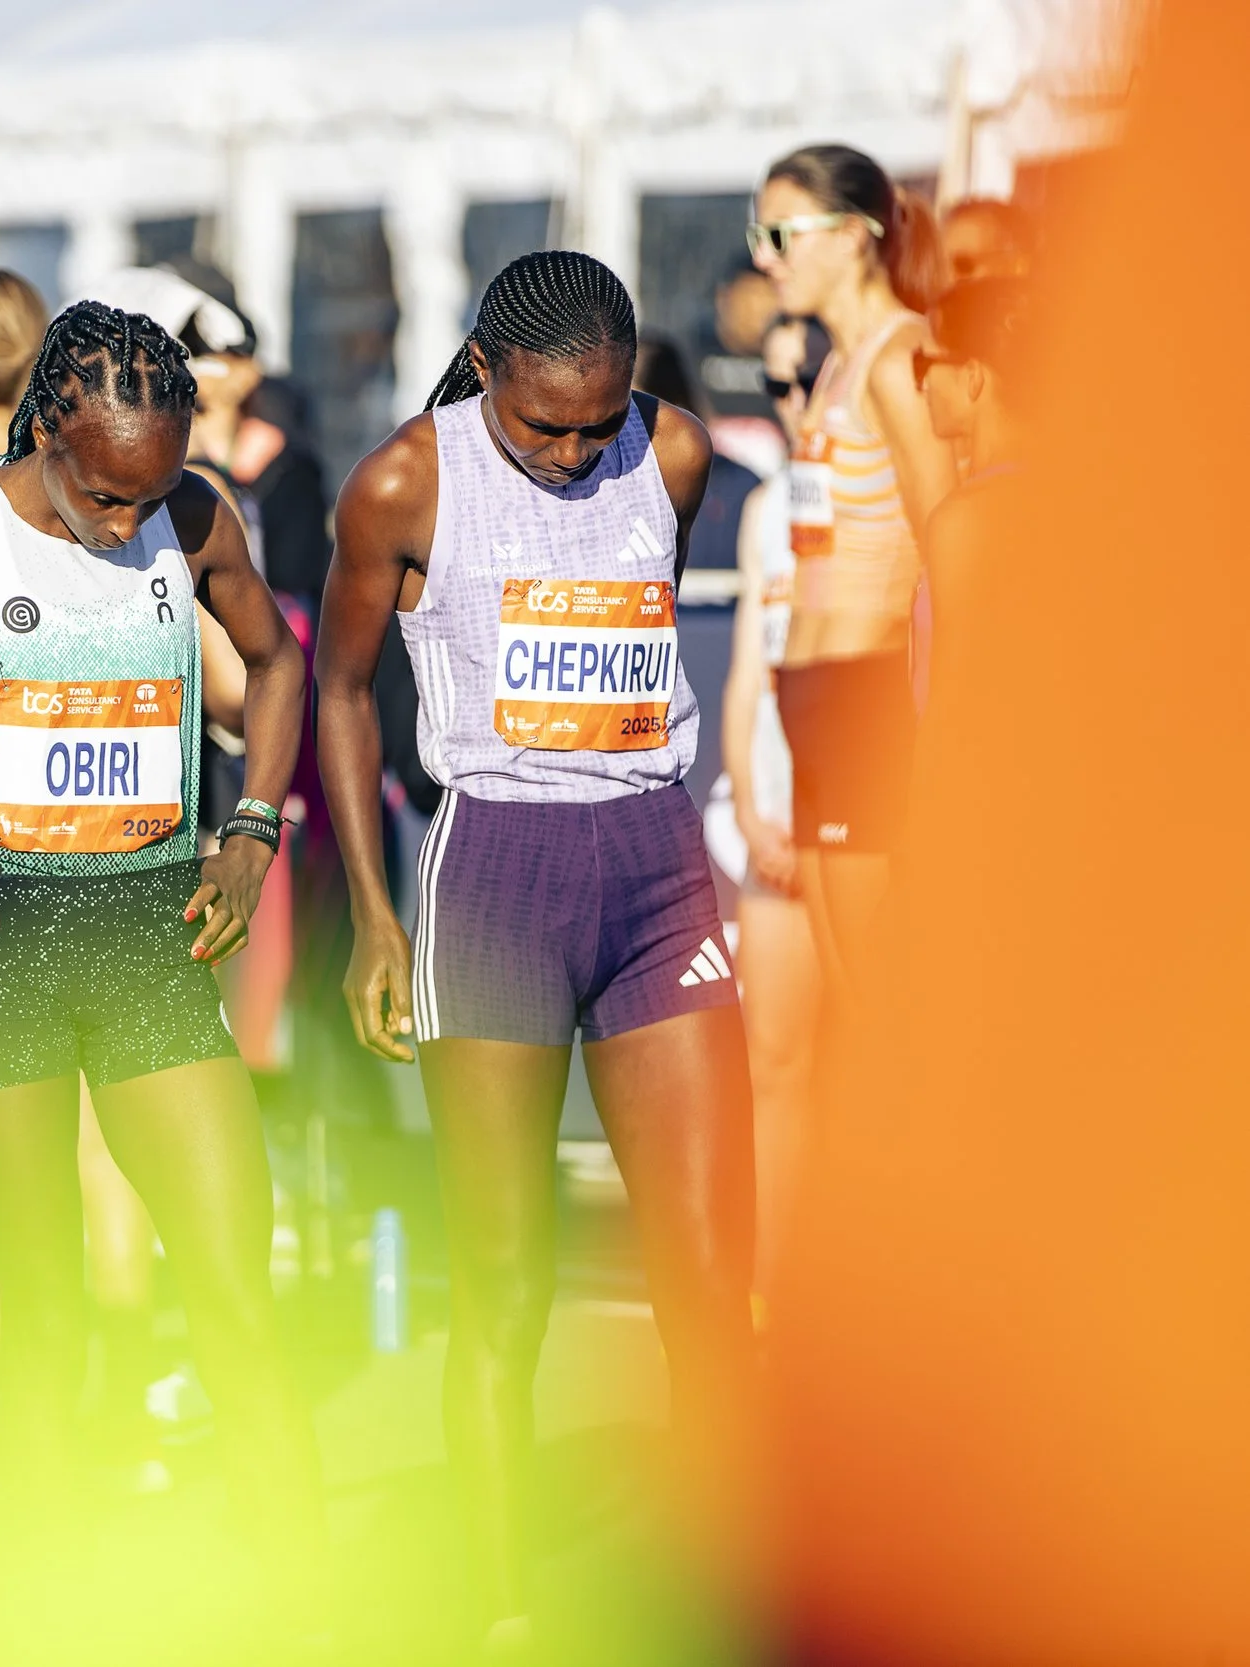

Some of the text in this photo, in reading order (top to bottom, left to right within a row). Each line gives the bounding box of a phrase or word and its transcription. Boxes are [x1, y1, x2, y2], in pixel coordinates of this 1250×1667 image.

[573, 587, 598, 595] TATA
[527, 587, 569, 613] tcs
[572, 595, 628, 606] CONSULTANCY
[572, 605, 608, 614] SERVICES
[640, 605, 662, 614] TATA
[505, 639, 671, 693] CHEPKIRUI
[67, 687, 92, 696] TATA
[22, 686, 64, 715] tcs
[66, 696, 122, 706] CONSULTANCY
[66, 706, 103, 715] SERVICES
[133, 703, 159, 713] TATA
[621, 716, 661, 735] 2025
[46, 741, 139, 797] OBIRI
[123, 818, 173, 837] 2025
